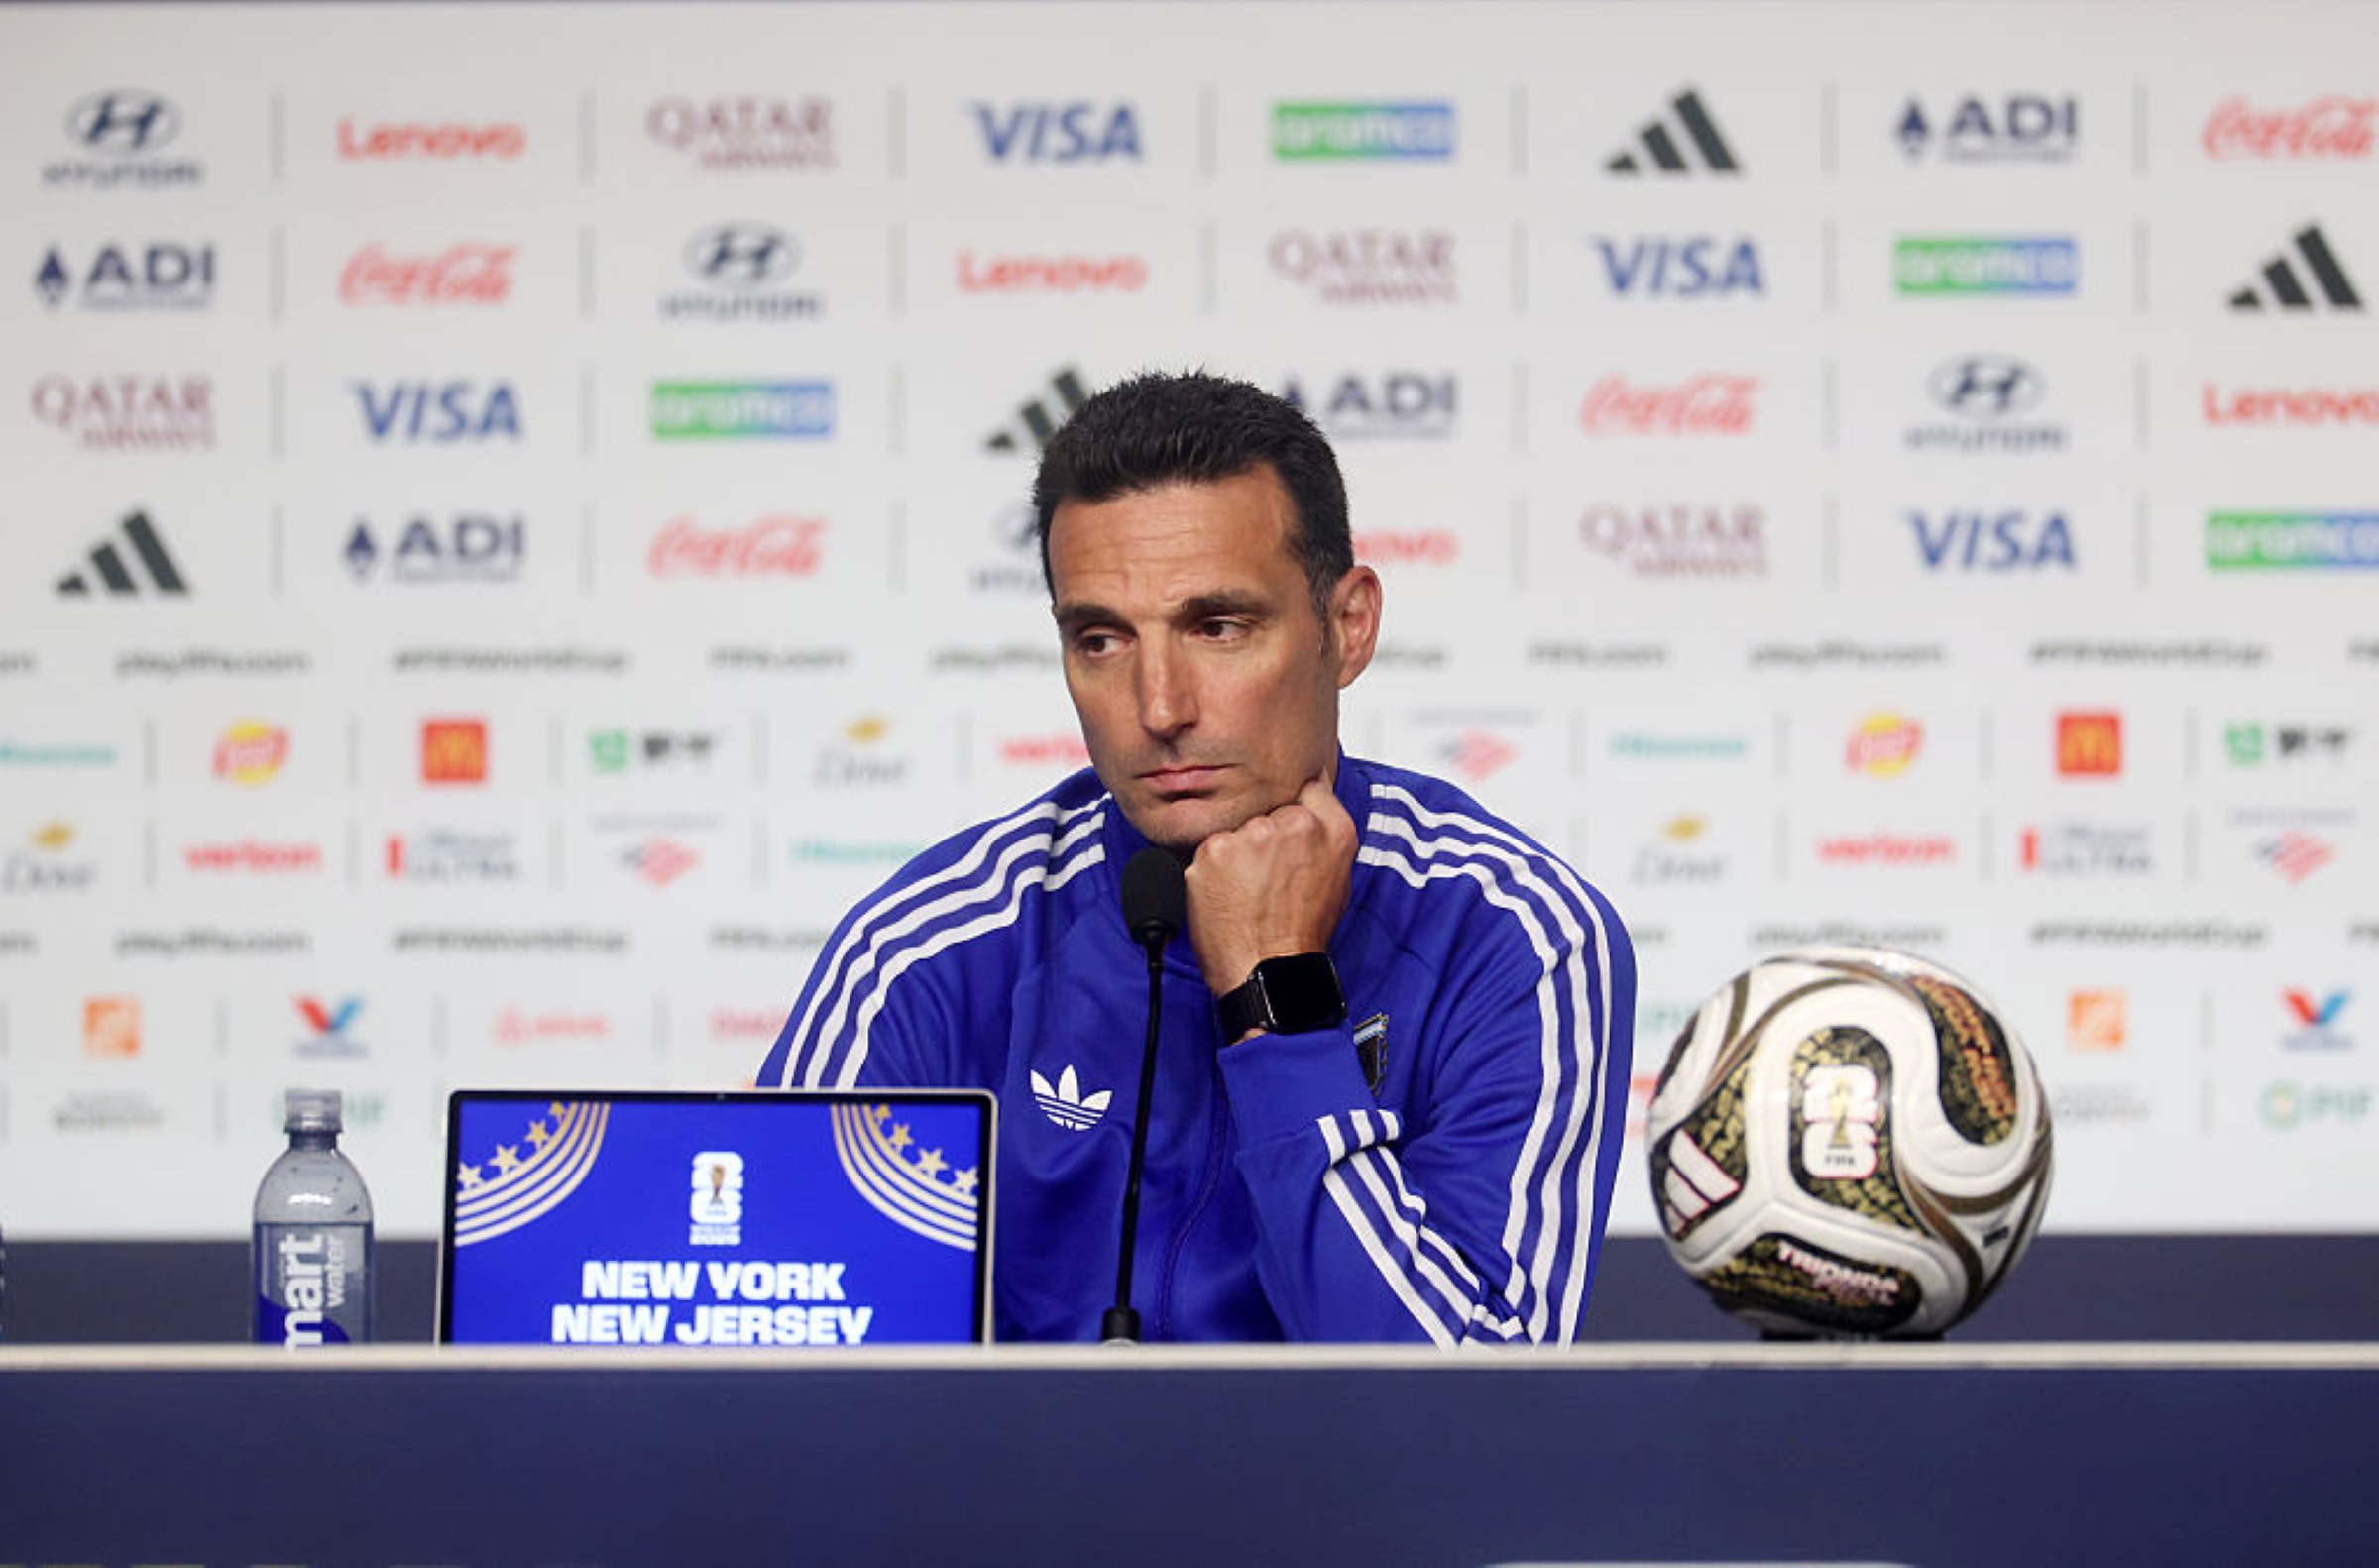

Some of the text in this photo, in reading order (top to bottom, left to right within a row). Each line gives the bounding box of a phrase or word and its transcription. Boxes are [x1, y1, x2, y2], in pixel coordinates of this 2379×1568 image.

[338, 122, 525, 159] Lenovo
[645, 97, 832, 149] QATAR
[975, 103, 1142, 163] VISA
[1947, 96, 2078, 141] ADI
[85, 245, 215, 285] ADI
[958, 255, 1147, 292] Lenovo
[1267, 231, 1454, 280] QATAR
[1598, 238, 1763, 296] VISA
[30, 376, 211, 424] QATAR
[356, 383, 521, 441] VISA
[1325, 374, 1455, 419] ADI
[395, 517, 524, 561] ADI
[1353, 531, 1458, 566] ovo
[1580, 505, 1764, 555] QATAR
[1910, 512, 2076, 571] VISA
[279, 1233, 324, 1350] mart
[582, 1260, 846, 1301] NEW YORK
[551, 1304, 873, 1345] NEW JERSEY
